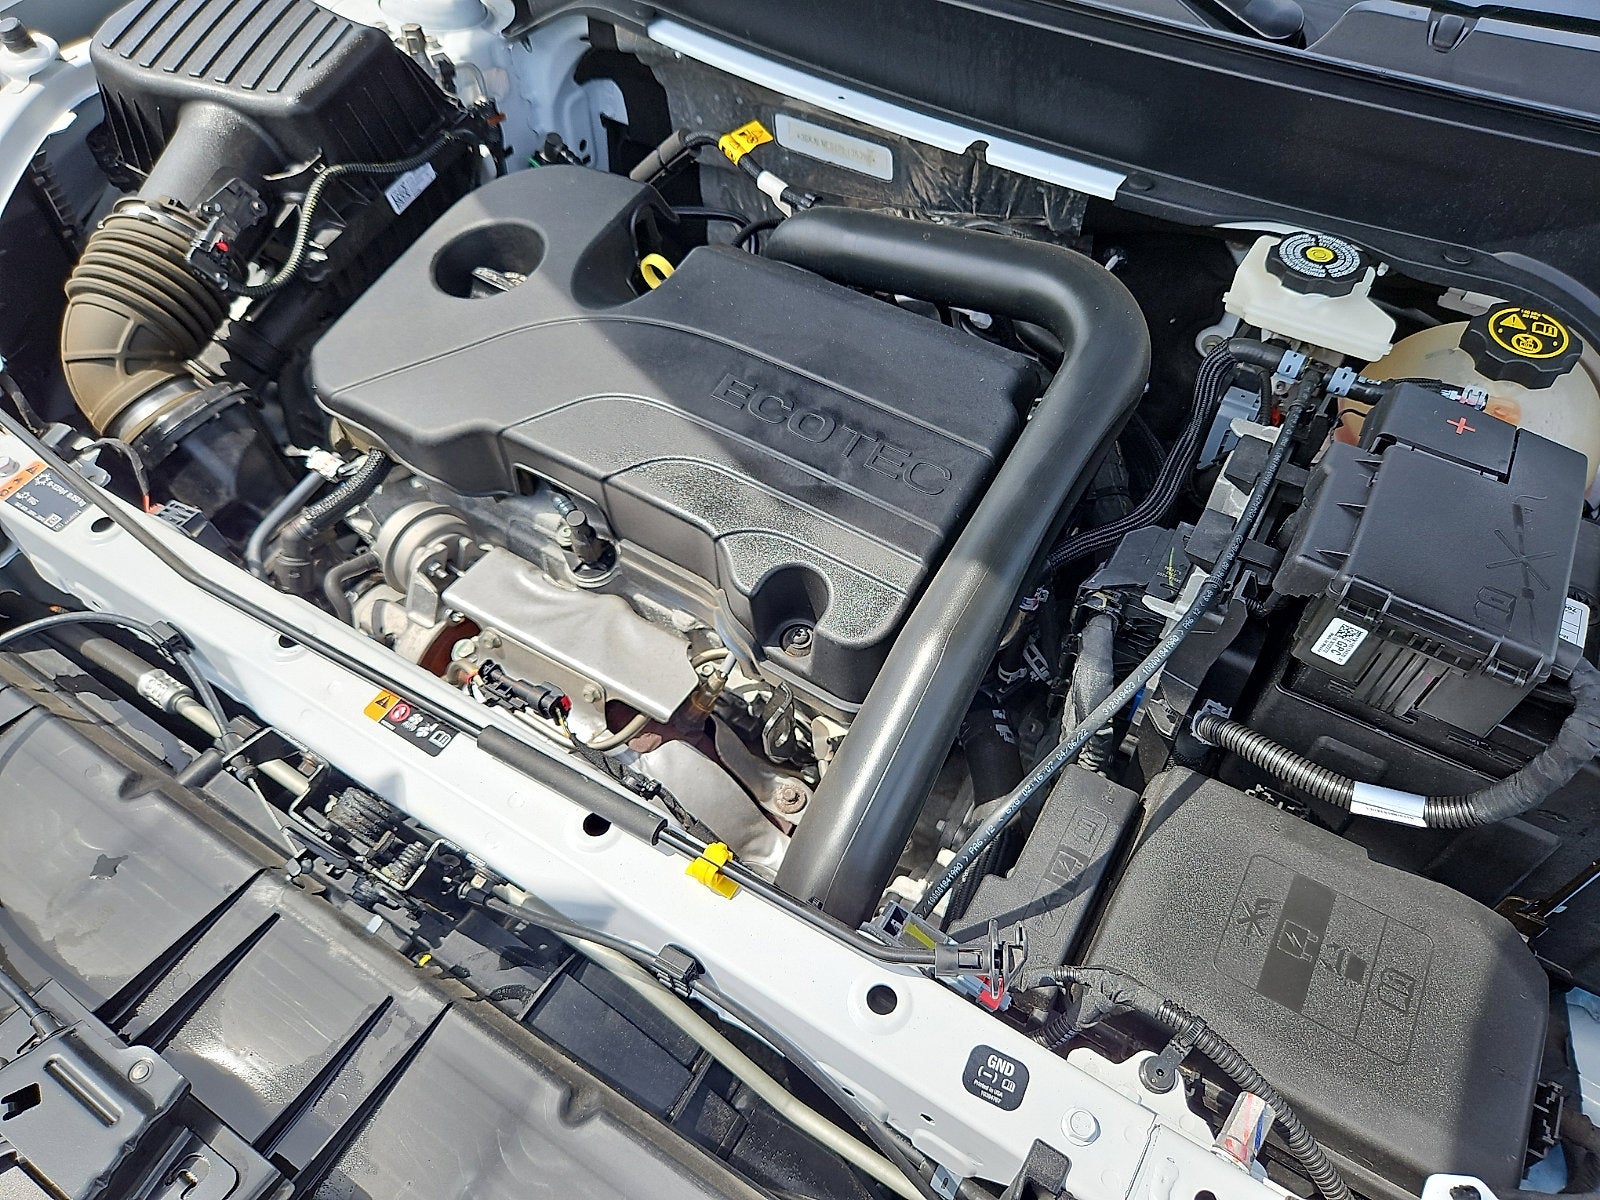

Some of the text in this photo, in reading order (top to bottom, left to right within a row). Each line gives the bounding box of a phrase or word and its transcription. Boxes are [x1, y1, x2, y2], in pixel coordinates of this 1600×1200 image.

[710, 373, 952, 496] ECOTEC
[1331, 641, 1348, 656] GPC
[1102, 682, 1136, 716] 312049423
[1056, 728, 1089, 761] 04/06/22
[988, 1055, 1015, 1077] GND
